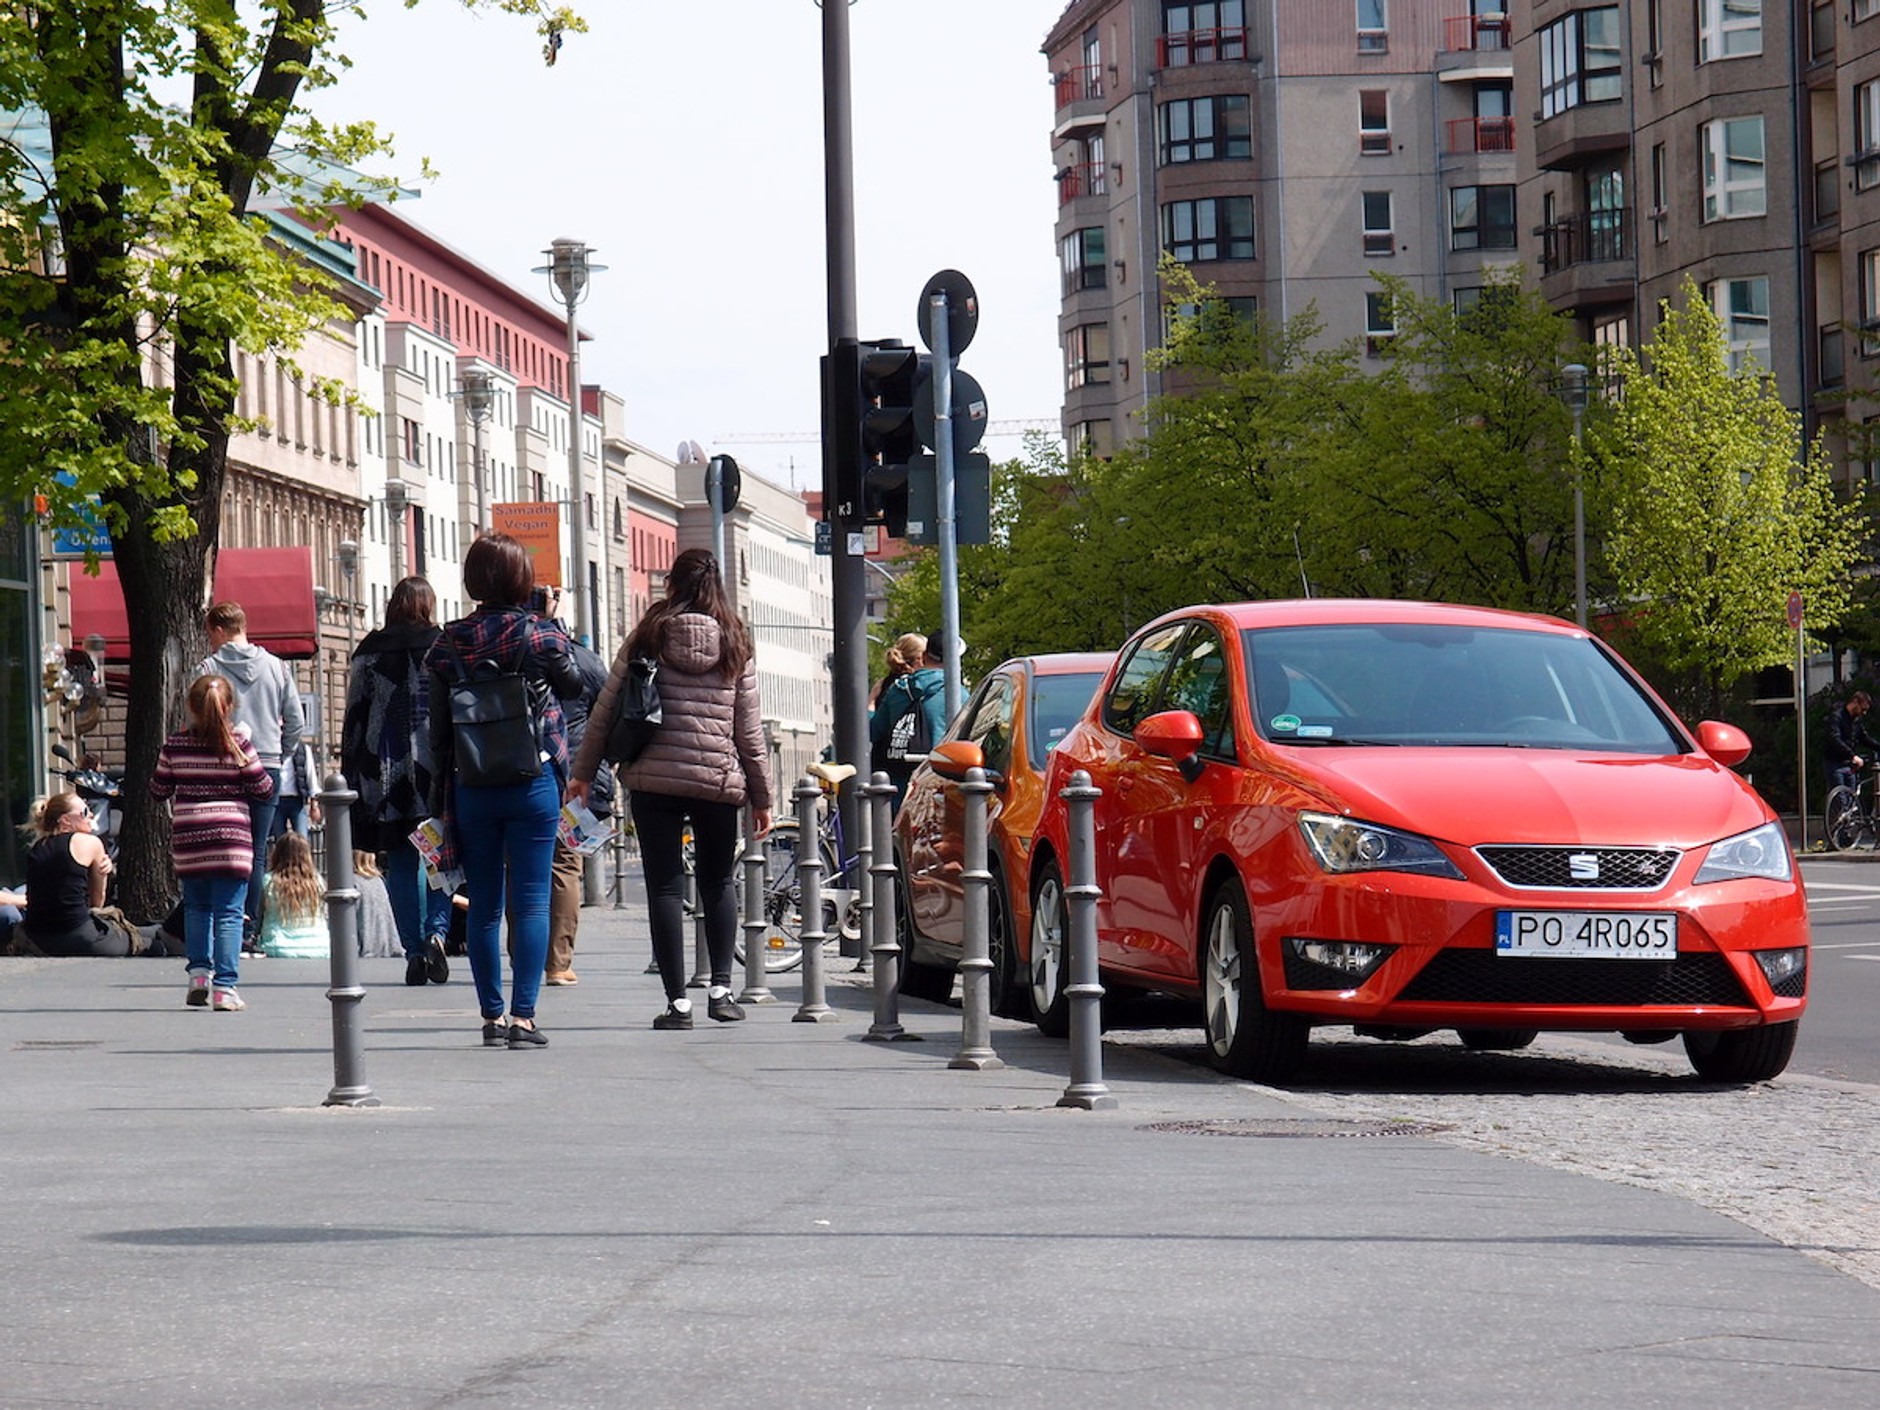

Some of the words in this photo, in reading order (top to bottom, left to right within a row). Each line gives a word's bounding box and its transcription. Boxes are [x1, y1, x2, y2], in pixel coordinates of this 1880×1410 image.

[495, 504, 557, 516] Samadhi
[838, 501, 852, 516] K3
[504, 520, 548, 531] Vegan
[1518, 916, 1563, 946] PO
[1576, 918, 1669, 948] 4R065
[1499, 934, 1510, 945] PL
